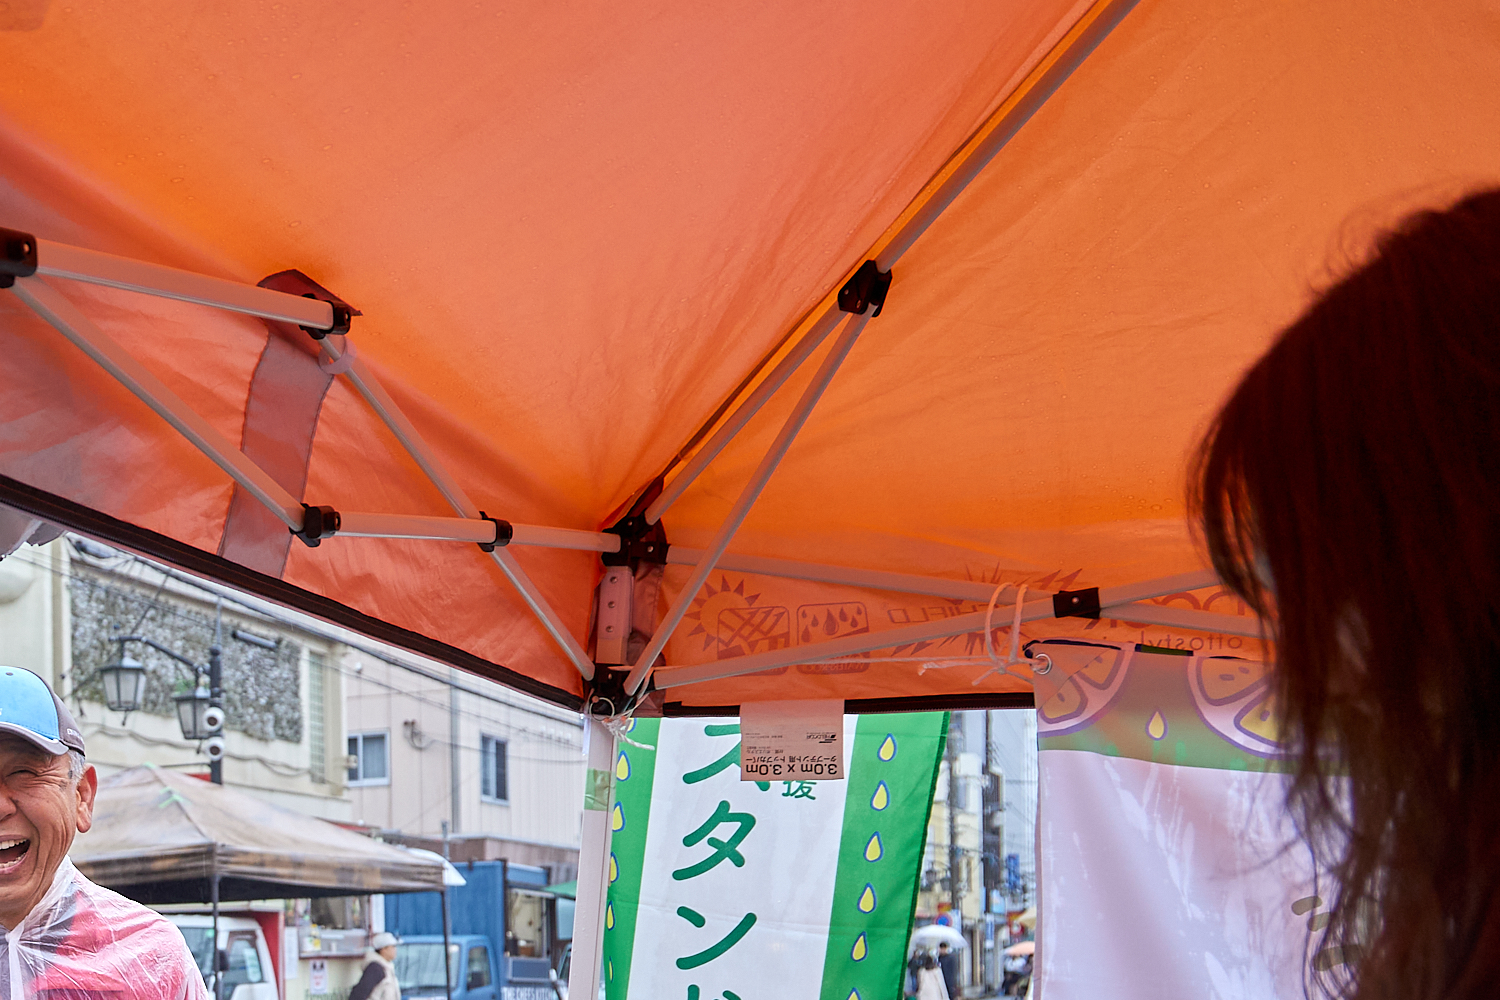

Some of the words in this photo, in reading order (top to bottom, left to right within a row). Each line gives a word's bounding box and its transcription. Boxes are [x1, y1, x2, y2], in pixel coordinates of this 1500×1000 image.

[746, 763, 782, 775] 3.0m
[787, 763, 796, 773] x
[801, 763, 838, 775] 3.0m
